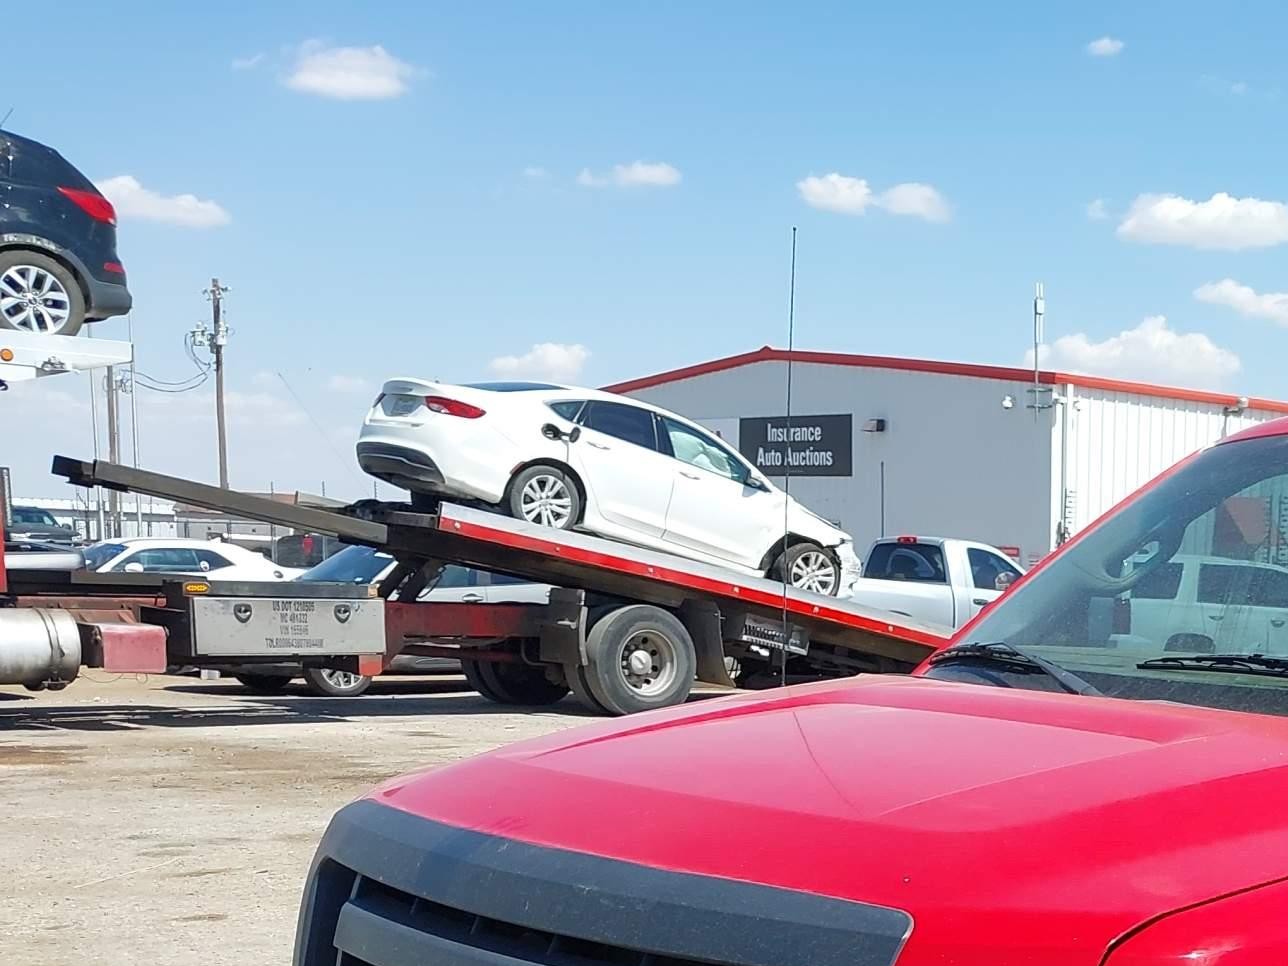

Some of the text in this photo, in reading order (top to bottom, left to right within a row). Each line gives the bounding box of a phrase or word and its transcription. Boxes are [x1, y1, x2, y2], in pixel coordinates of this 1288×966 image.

[767, 423, 822, 442] Insurance
[757, 447, 833, 466] Auto Auctions
